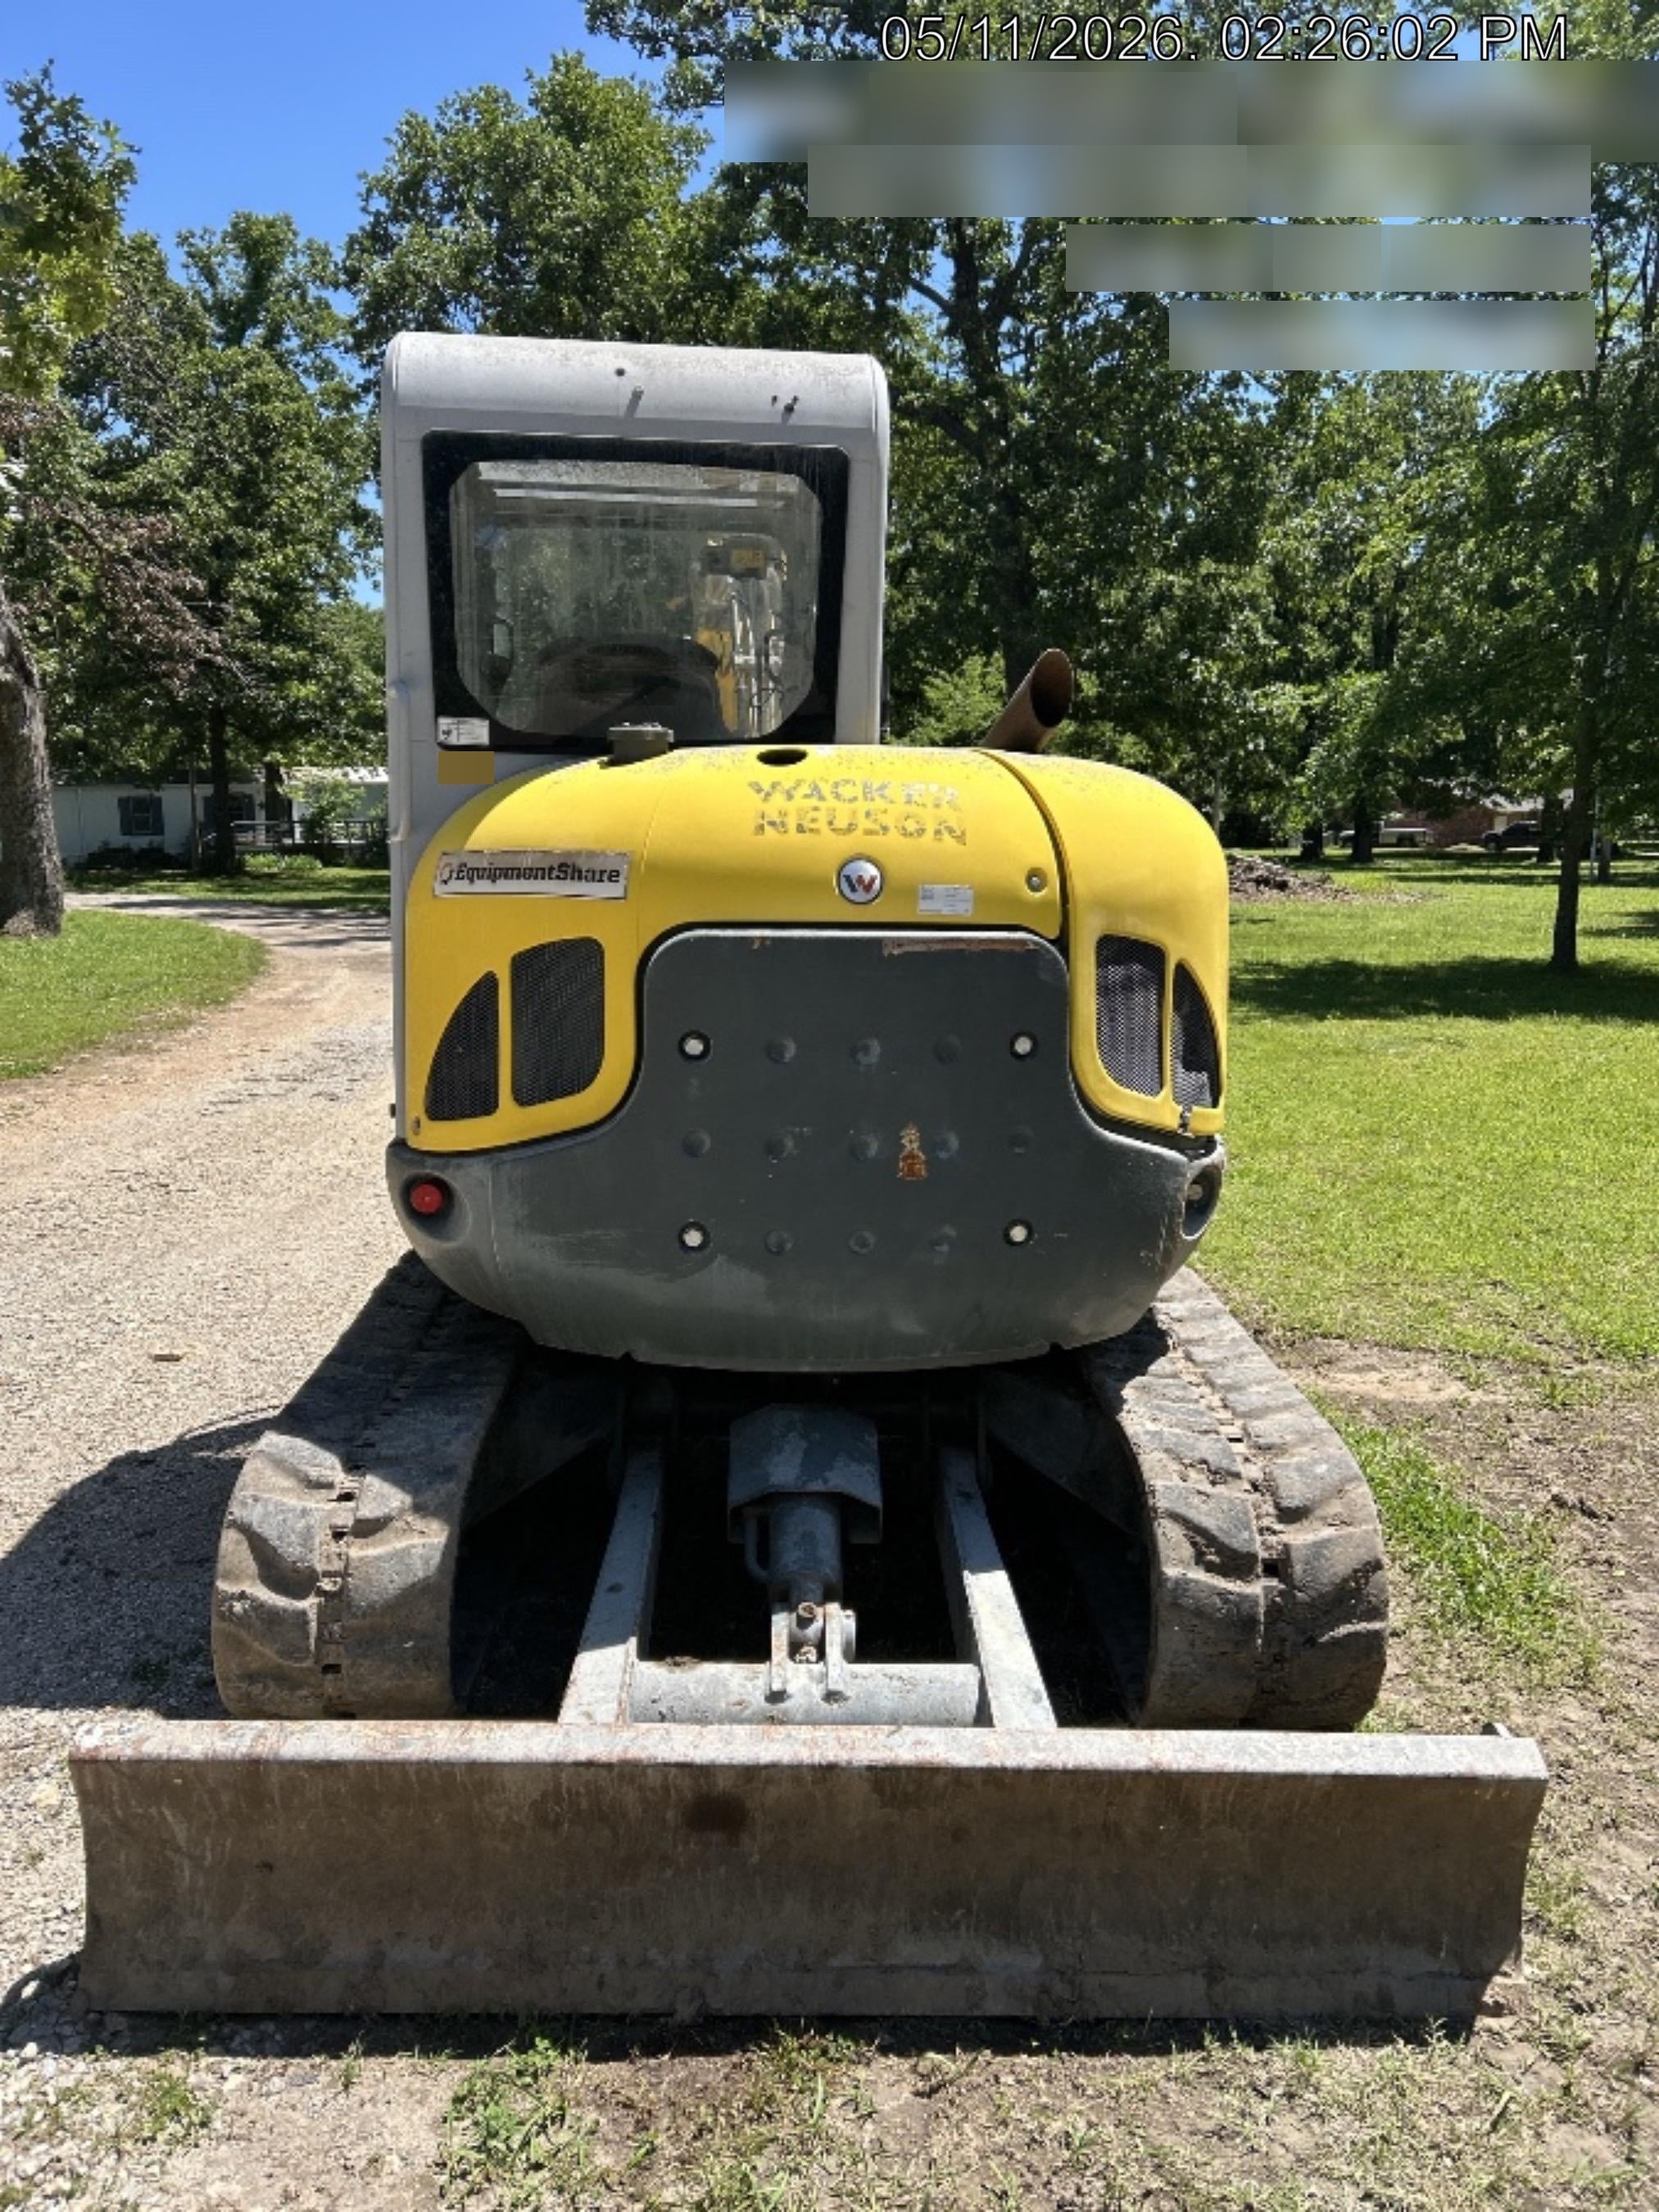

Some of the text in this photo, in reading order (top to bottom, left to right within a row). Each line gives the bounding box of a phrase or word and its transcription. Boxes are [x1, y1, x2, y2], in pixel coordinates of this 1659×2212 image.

[749, 778, 962, 811] WACKER
[754, 805, 968, 845] NEUSON
[455, 861, 621, 884] EquipmentShare
